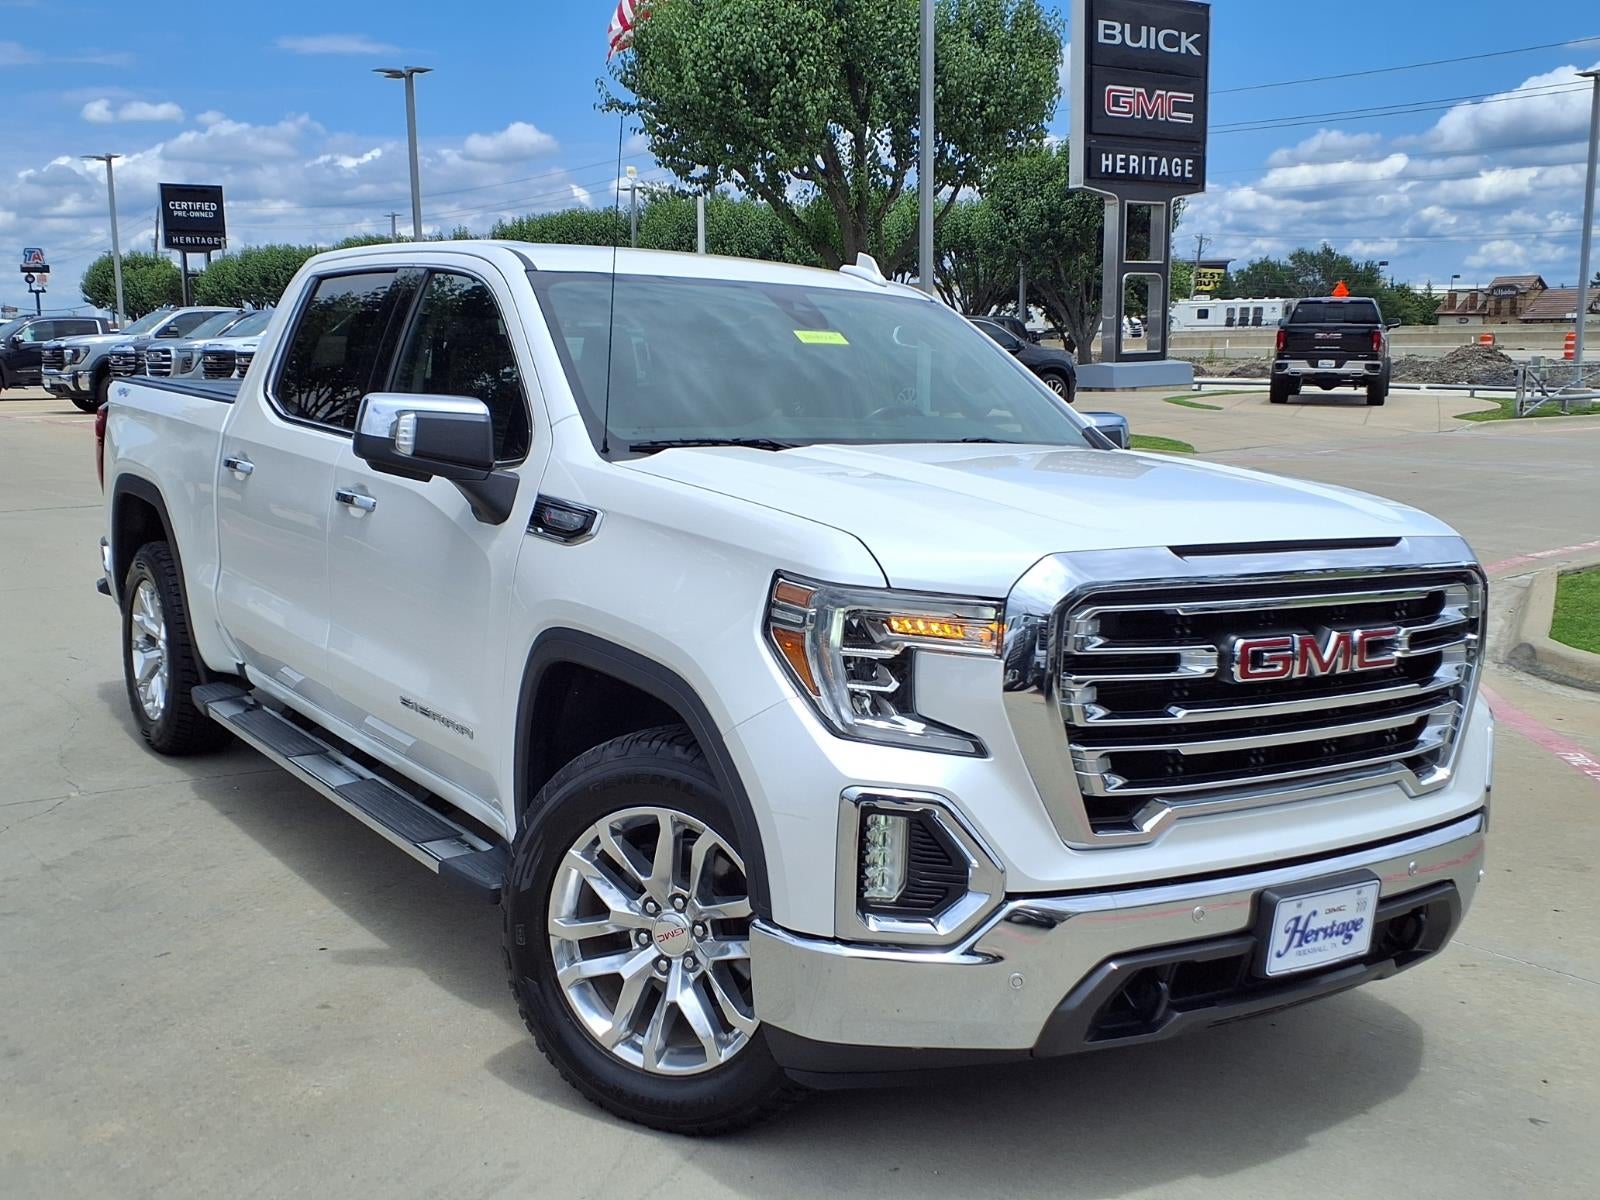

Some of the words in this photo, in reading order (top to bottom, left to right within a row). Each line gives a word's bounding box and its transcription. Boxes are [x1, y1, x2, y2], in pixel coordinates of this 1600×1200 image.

[1097, 19, 1202, 56] BUICK
[1105, 84, 1194, 124] GMC
[1101, 152, 1194, 178] HERITAGE
[169, 201, 218, 211] CERTIFIED
[173, 210, 214, 218] PRE-OWNED
[172, 236, 220, 245] HERITAGE
[25, 249, 44, 264] TA
[1195, 271, 1222, 279] BEST
[1233, 626, 1398, 682] GMC
[399, 695, 474, 740] SIERRA
[656, 927, 684, 943] GMC
[1275, 909, 1364, 958] Heritage
